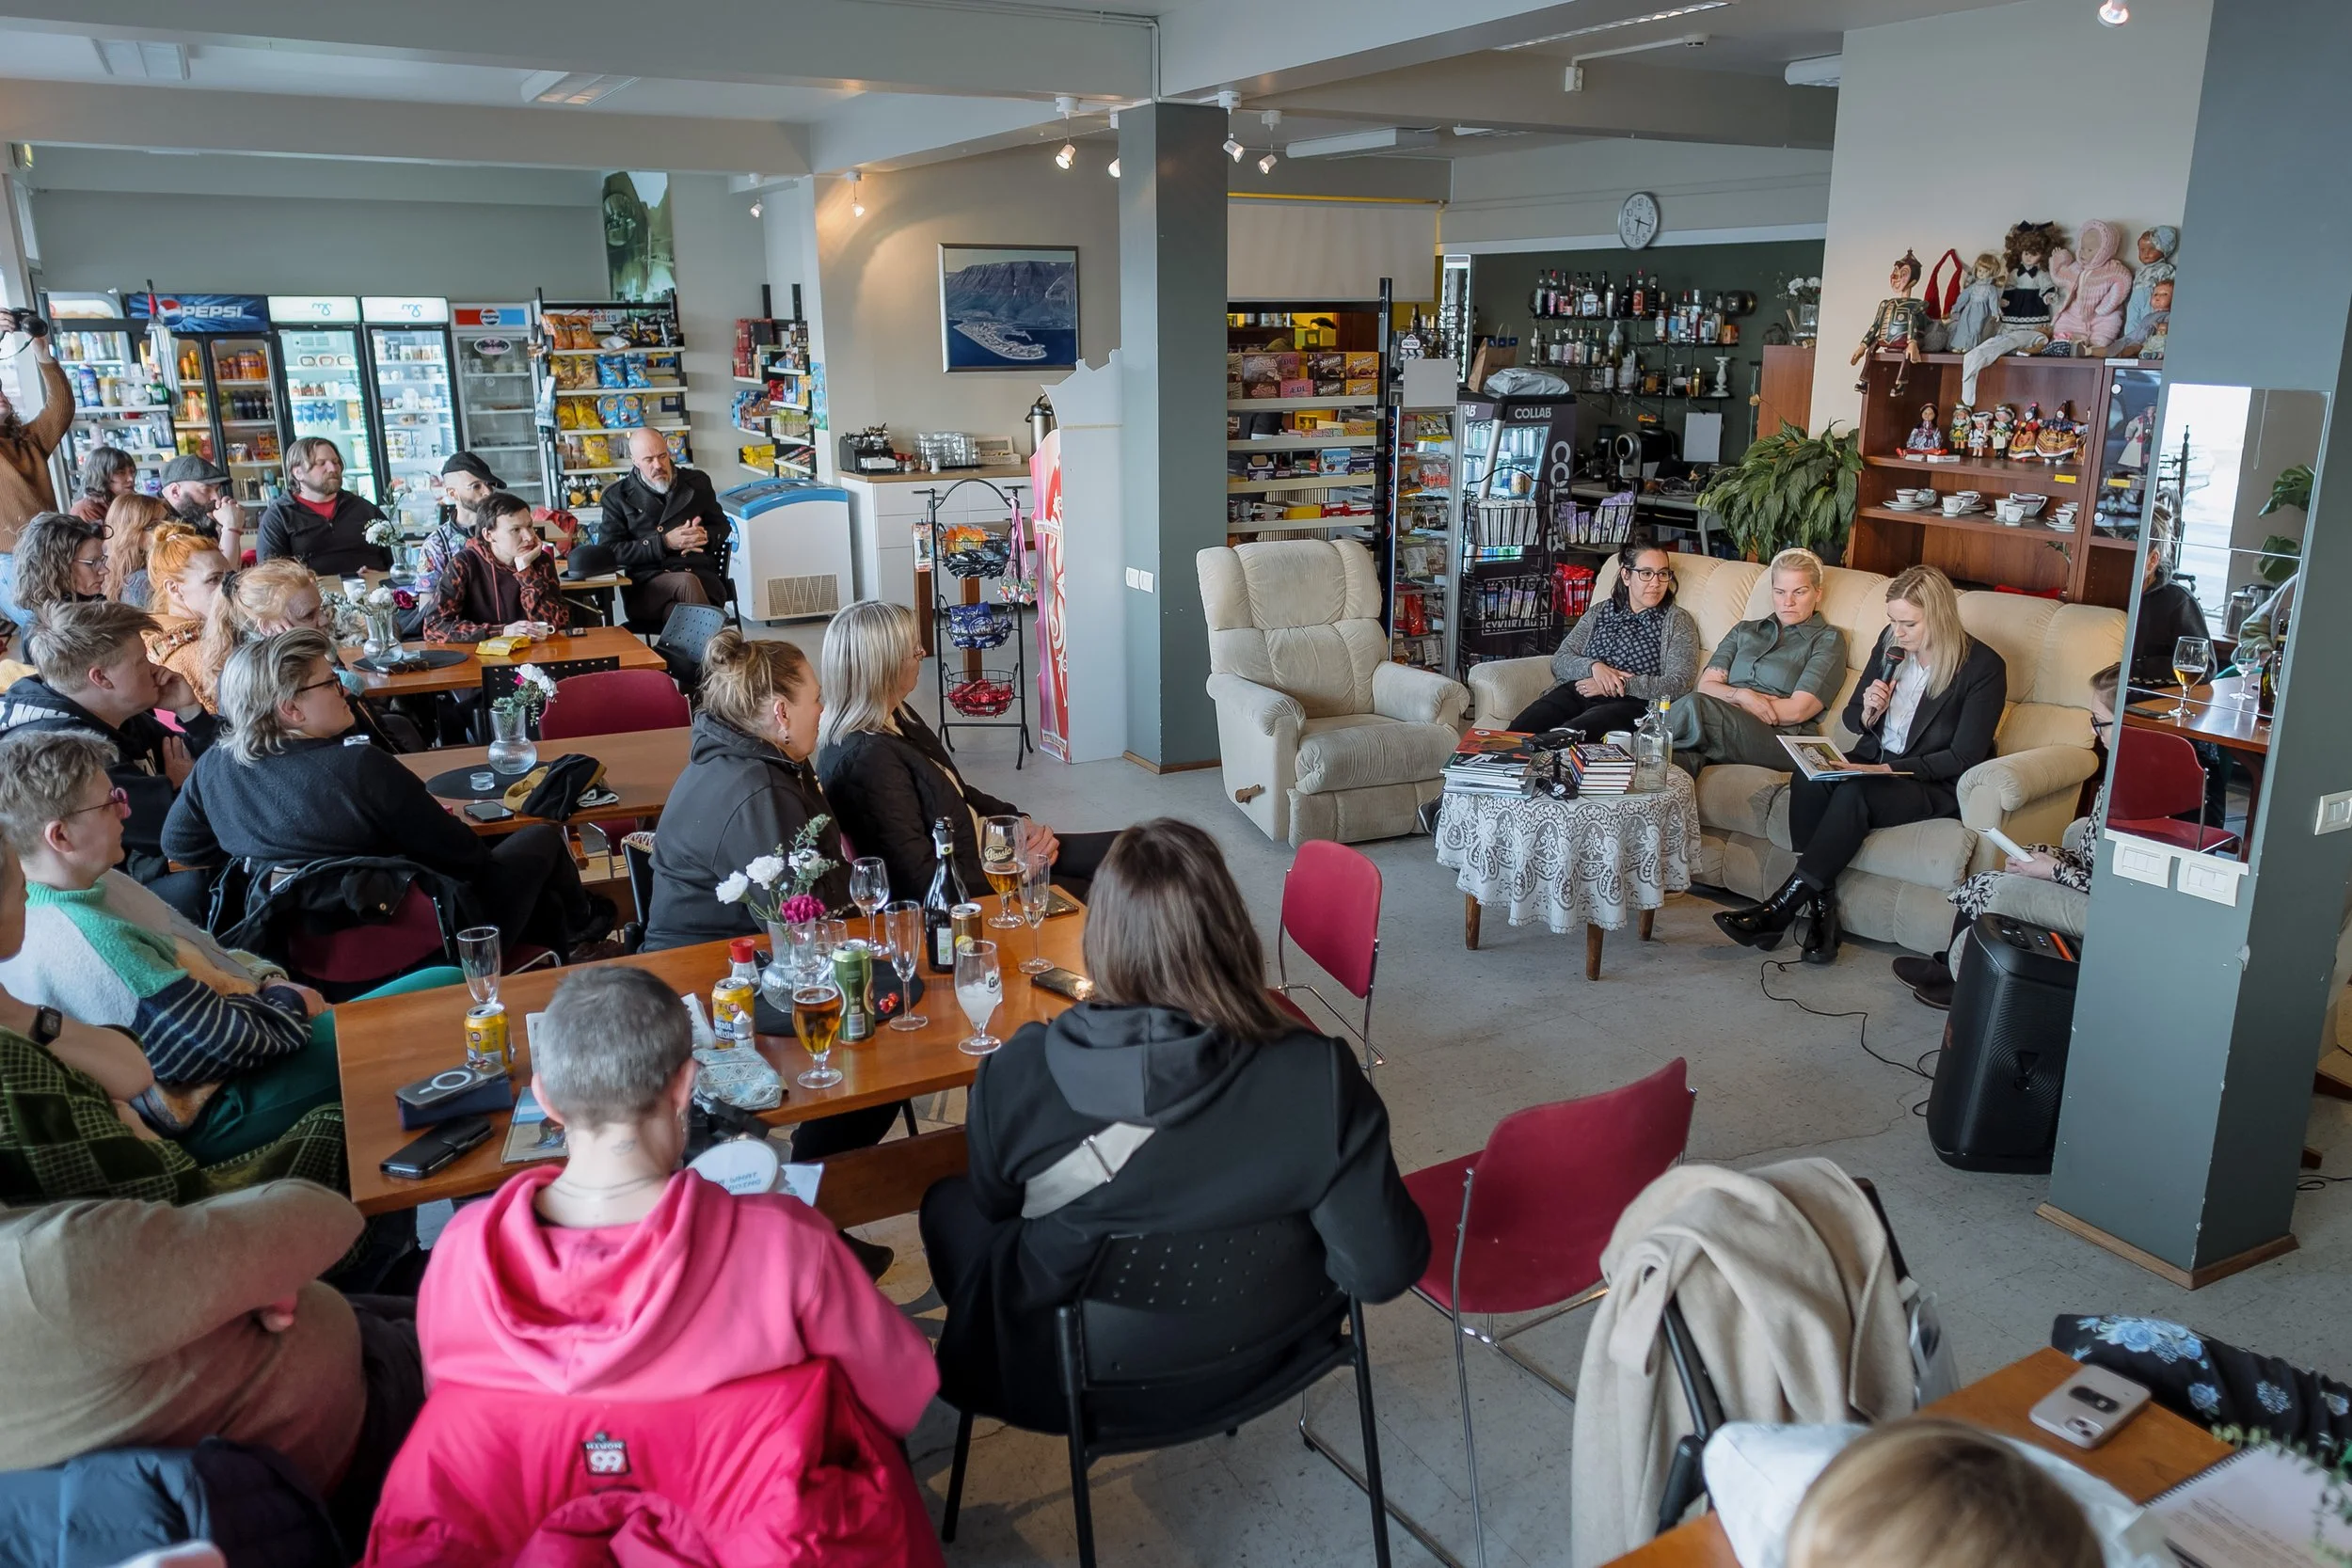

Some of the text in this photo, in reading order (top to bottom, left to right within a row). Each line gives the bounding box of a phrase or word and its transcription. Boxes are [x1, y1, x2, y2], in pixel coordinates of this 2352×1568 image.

[182, 306, 243, 318] PEPSI
[1515, 406, 1552, 420] COLLAB
[989, 976, 1000, 988] Gu
